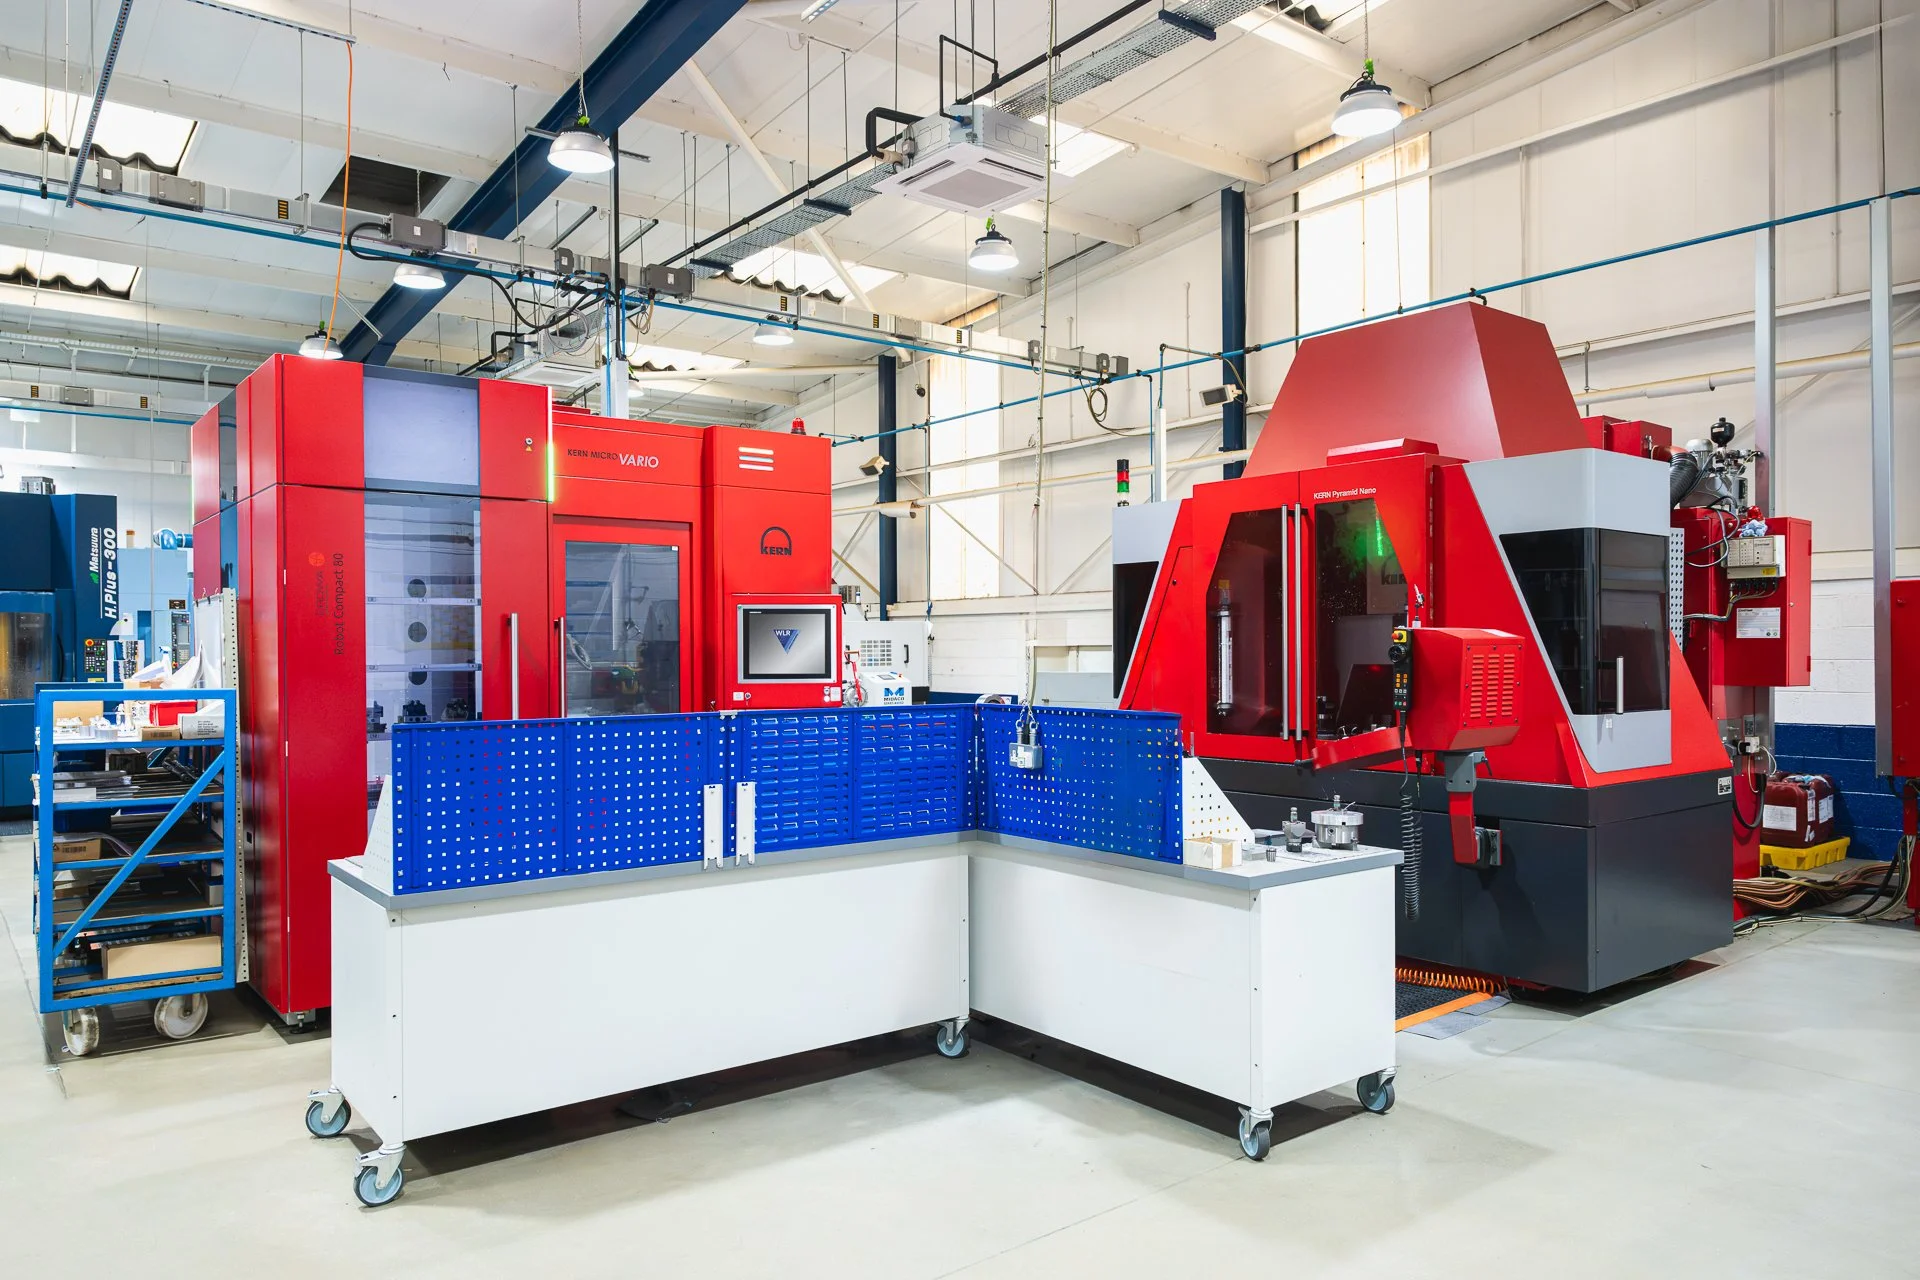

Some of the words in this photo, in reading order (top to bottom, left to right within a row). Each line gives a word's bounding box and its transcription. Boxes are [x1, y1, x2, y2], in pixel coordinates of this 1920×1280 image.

[567, 448, 588, 458] KERN
[590, 451, 618, 460] MICRO
[619, 453, 659, 468] VARIO
[1313, 491, 1331, 499] KERN
[1332, 488, 1358, 498] Pyramid
[1360, 487, 1377, 495] Nano
[89, 527, 99, 573] Matsuura
[333, 553, 344, 567] 80
[103, 527, 117, 619] H.Plus-300
[333, 569, 345, 619] Compact
[333, 622, 345, 655] Robot
